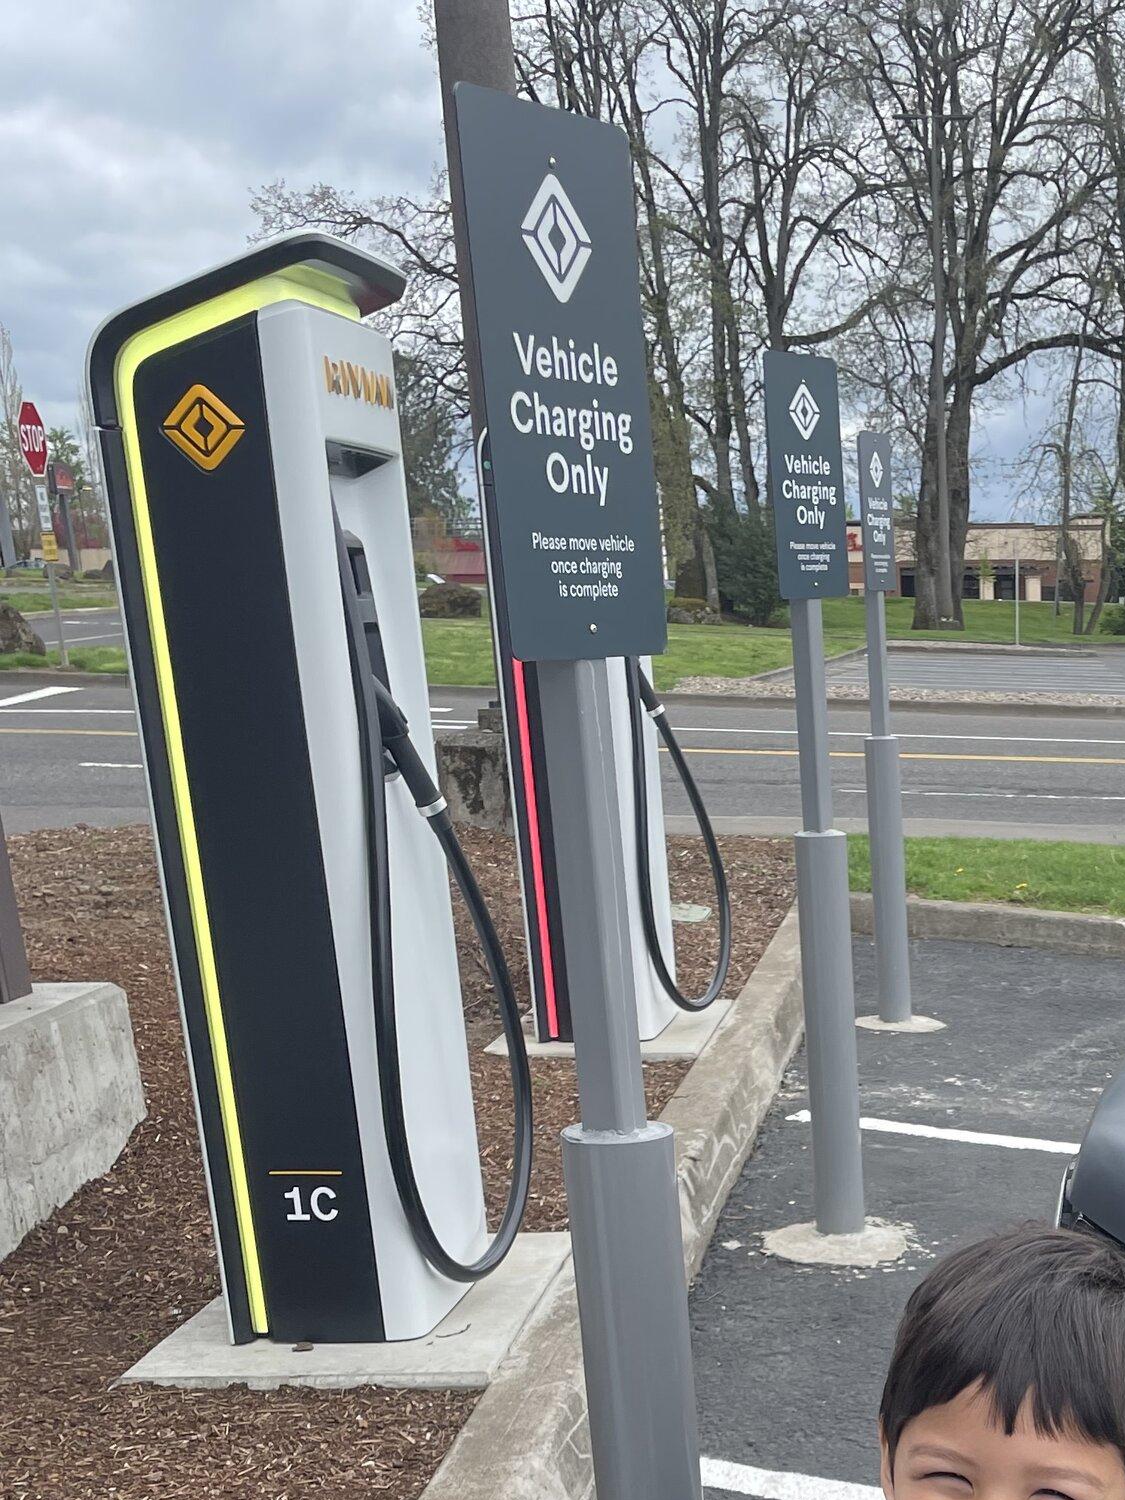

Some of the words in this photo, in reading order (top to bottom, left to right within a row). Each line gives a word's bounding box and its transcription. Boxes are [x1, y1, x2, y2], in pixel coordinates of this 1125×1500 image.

[512, 331, 619, 387] Vehicle
[510, 390, 634, 455] Charging
[20, 424, 45, 453] STOP
[784, 453, 831, 475] Vehicle
[546, 451, 609, 507] Only
[782, 479, 837, 505] Charging
[796, 505, 825, 530] Only
[531, 532, 567, 550] Please
[568, 537, 598, 551] move
[598, 534, 635, 552] vehicle
[550, 560, 578, 574] once
[579, 557, 623, 579] charging
[558, 579, 568, 598] is
[569, 580, 619, 602] complete
[284, 1186, 339, 1222] 1C
